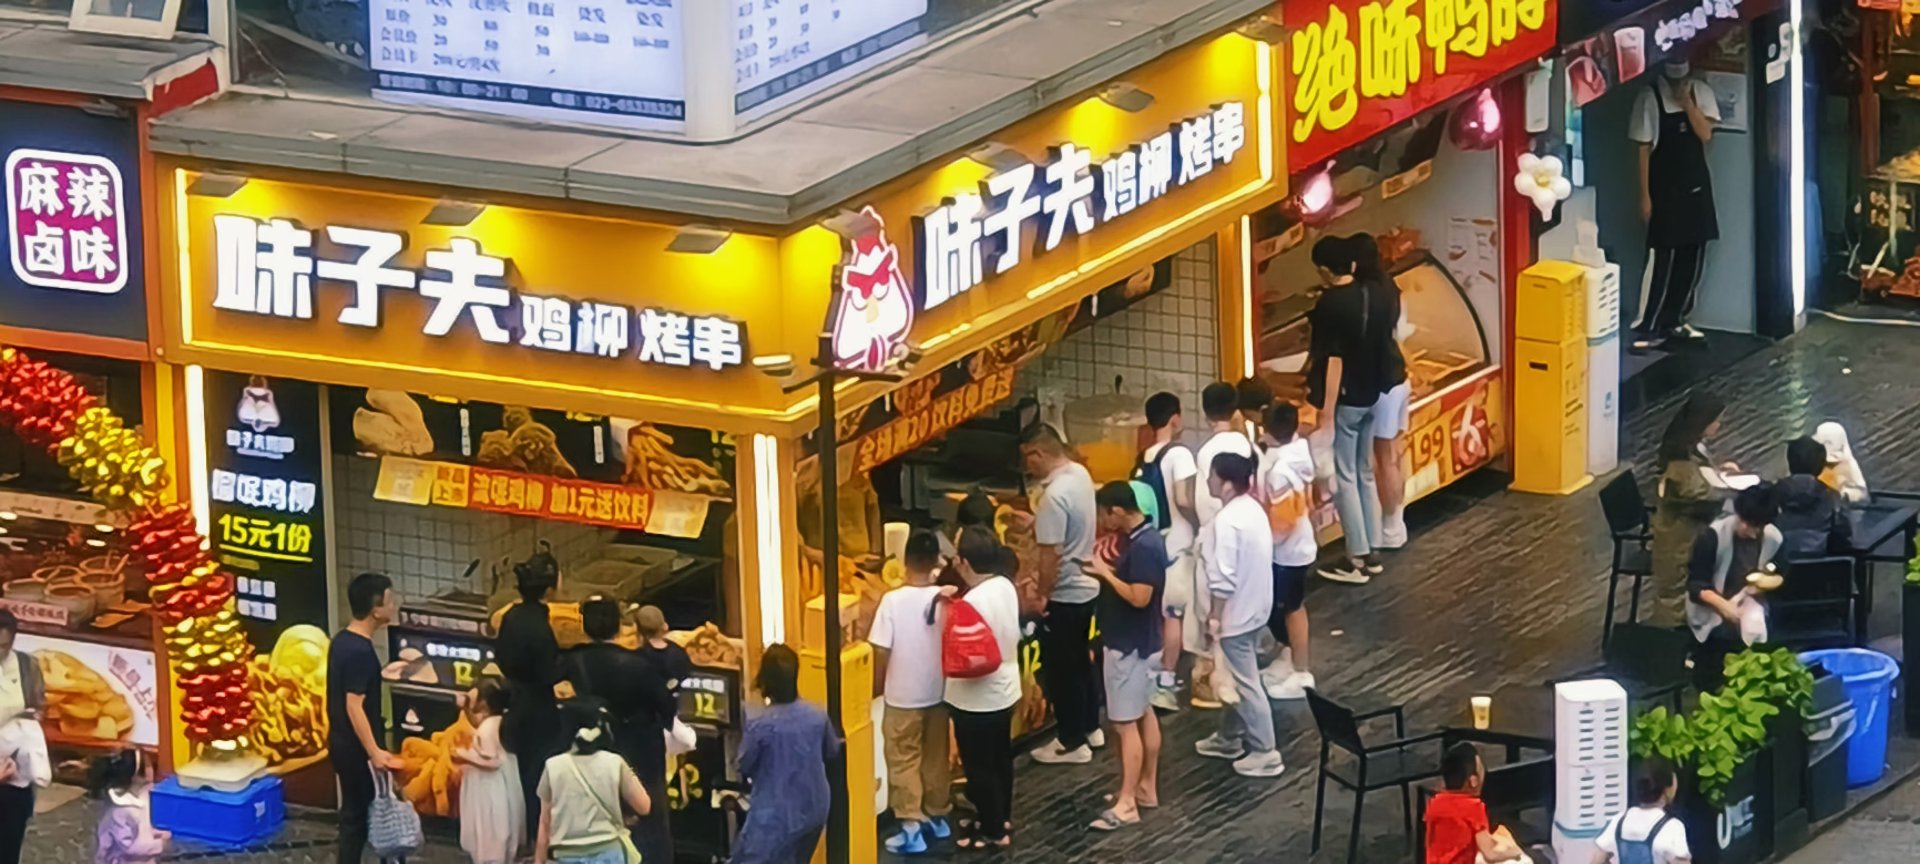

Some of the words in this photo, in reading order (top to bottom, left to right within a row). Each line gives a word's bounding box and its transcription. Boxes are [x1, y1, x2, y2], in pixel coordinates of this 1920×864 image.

[20, 162, 113, 221] 麻辣
[24, 220, 117, 280] 卤味
[924, 143, 1094, 311] 味子夫
[213, 215, 510, 343] 味子夫
[218, 514, 312, 553] 15元1份
[695, 693, 715, 719] 12
